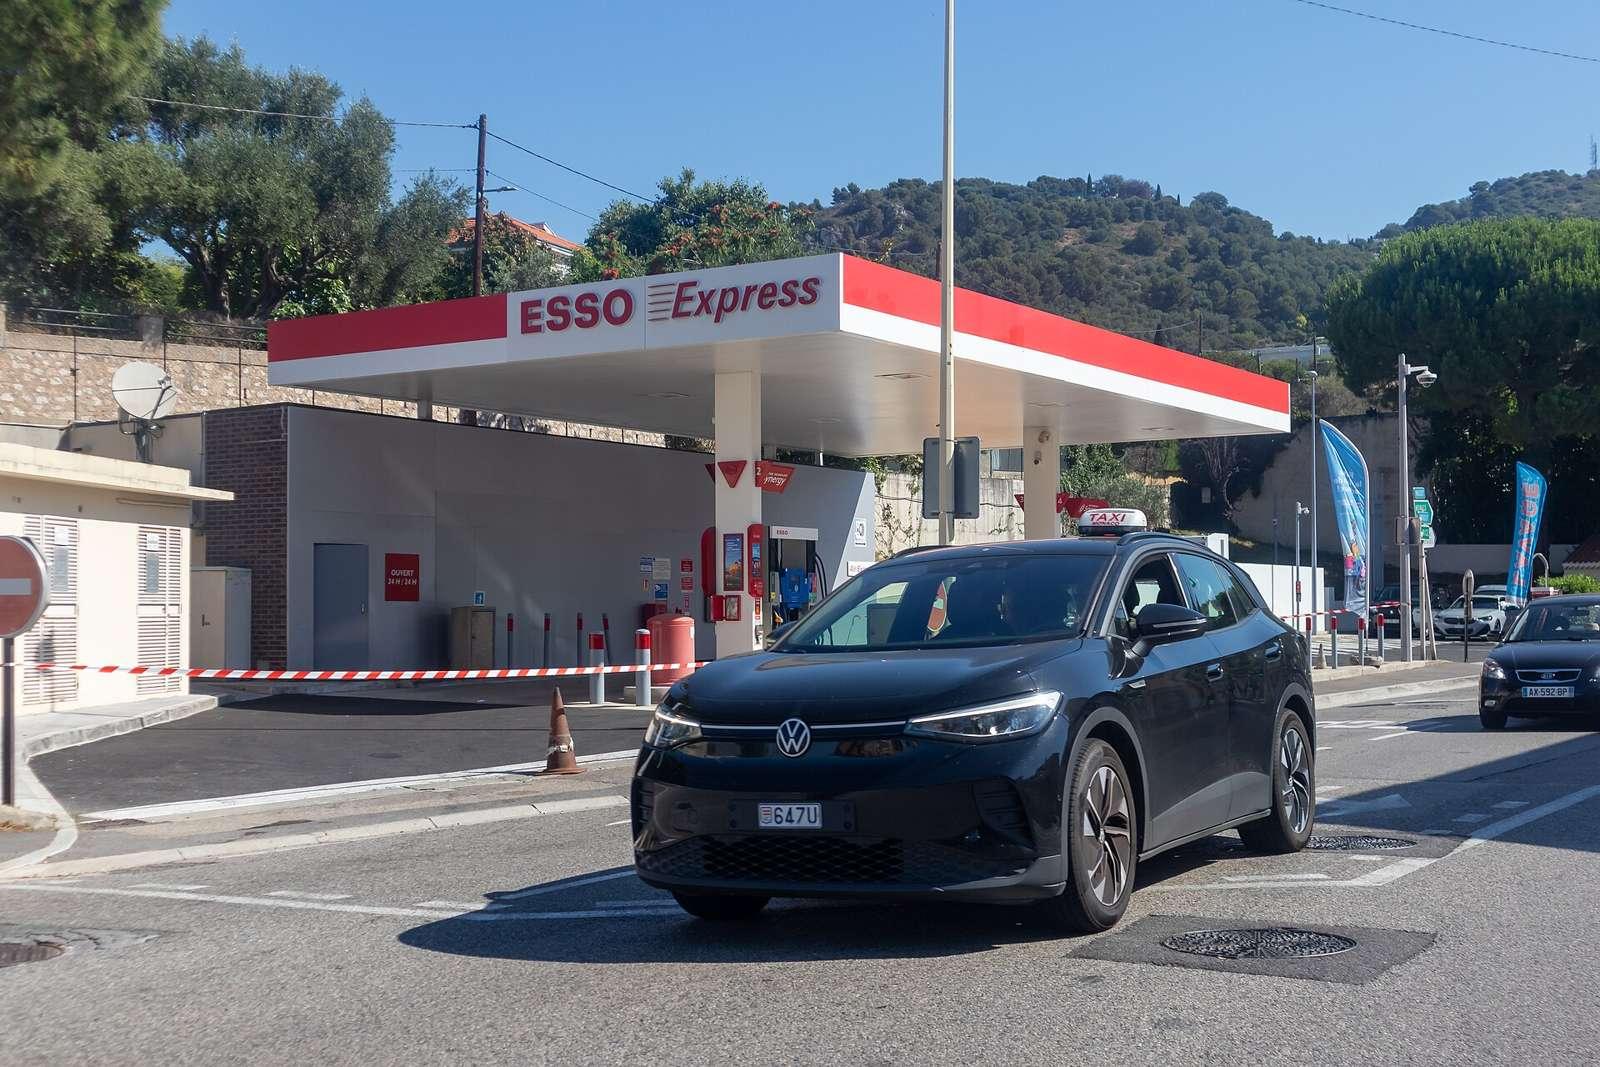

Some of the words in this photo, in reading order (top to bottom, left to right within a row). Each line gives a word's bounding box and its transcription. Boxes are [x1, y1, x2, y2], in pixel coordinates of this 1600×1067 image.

[520, 288, 634, 334] ESSO
[671, 277, 821, 323] Express
[1090, 514, 1126, 522] TAXI
[391, 569, 414, 577] OUVERT
[774, 806, 817, 825] 647U
